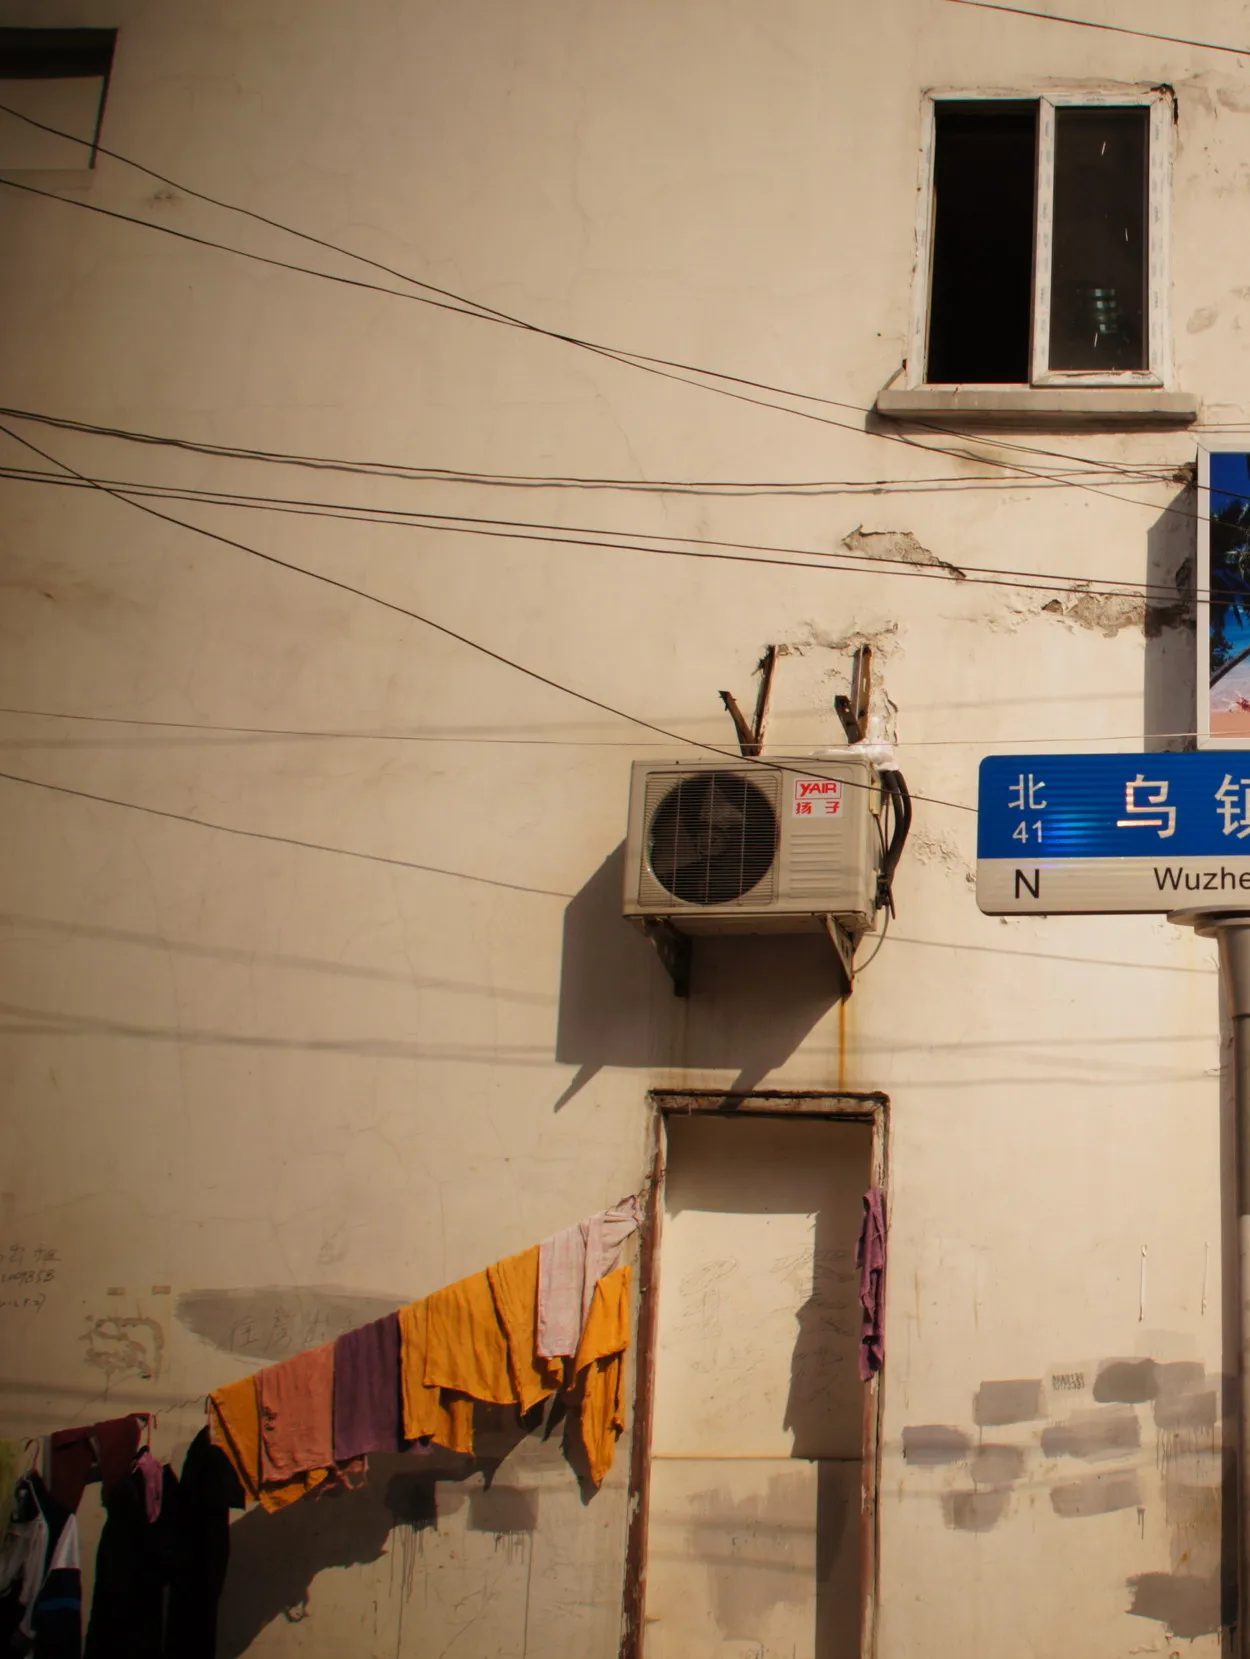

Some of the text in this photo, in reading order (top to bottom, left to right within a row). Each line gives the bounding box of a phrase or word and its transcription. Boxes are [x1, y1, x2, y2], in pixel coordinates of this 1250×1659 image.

[1008, 774, 1048, 811] 北
[1012, 819, 1043, 844] 41
[1014, 868, 1040, 899] N
